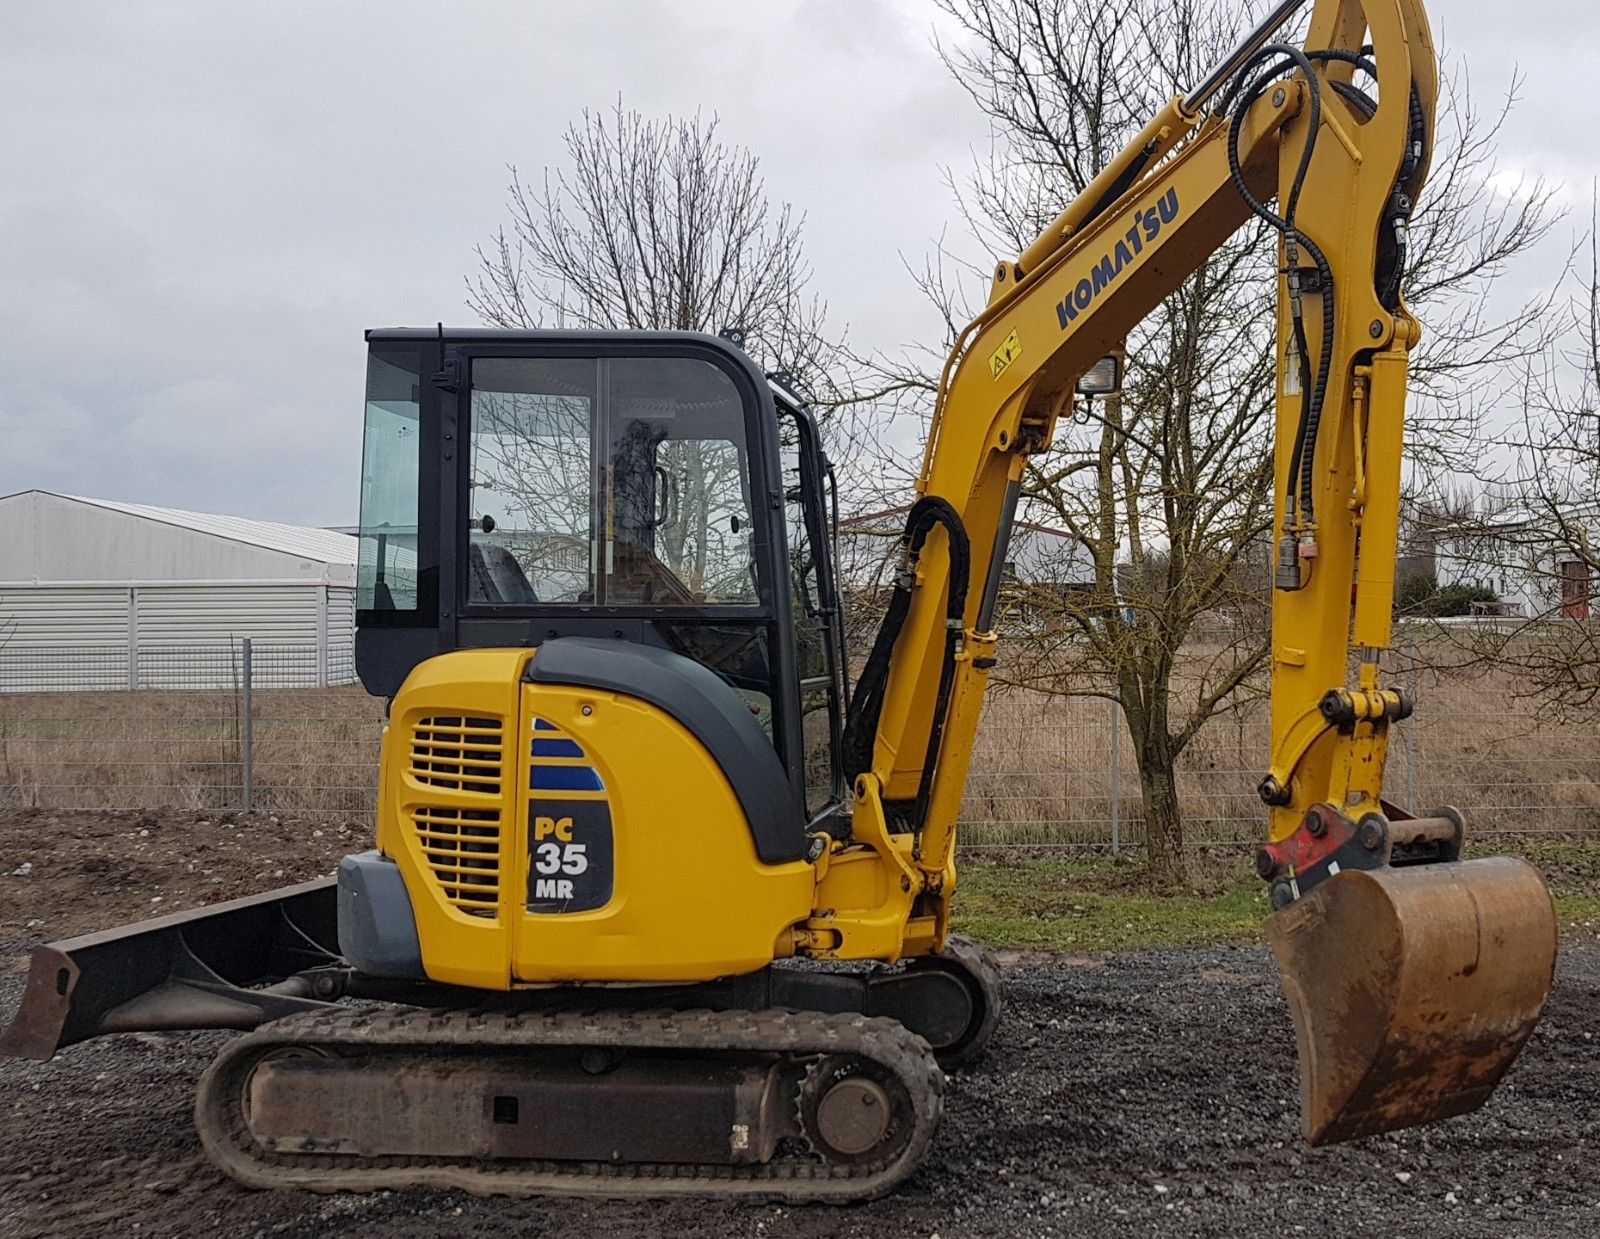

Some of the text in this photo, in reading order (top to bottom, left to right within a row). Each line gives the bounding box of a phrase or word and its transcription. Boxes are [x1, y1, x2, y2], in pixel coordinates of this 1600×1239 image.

[1055, 186, 1180, 330] KOMATSU
[534, 816, 573, 842] PC
[535, 843, 588, 875] 35
[535, 879, 574, 899] MR
